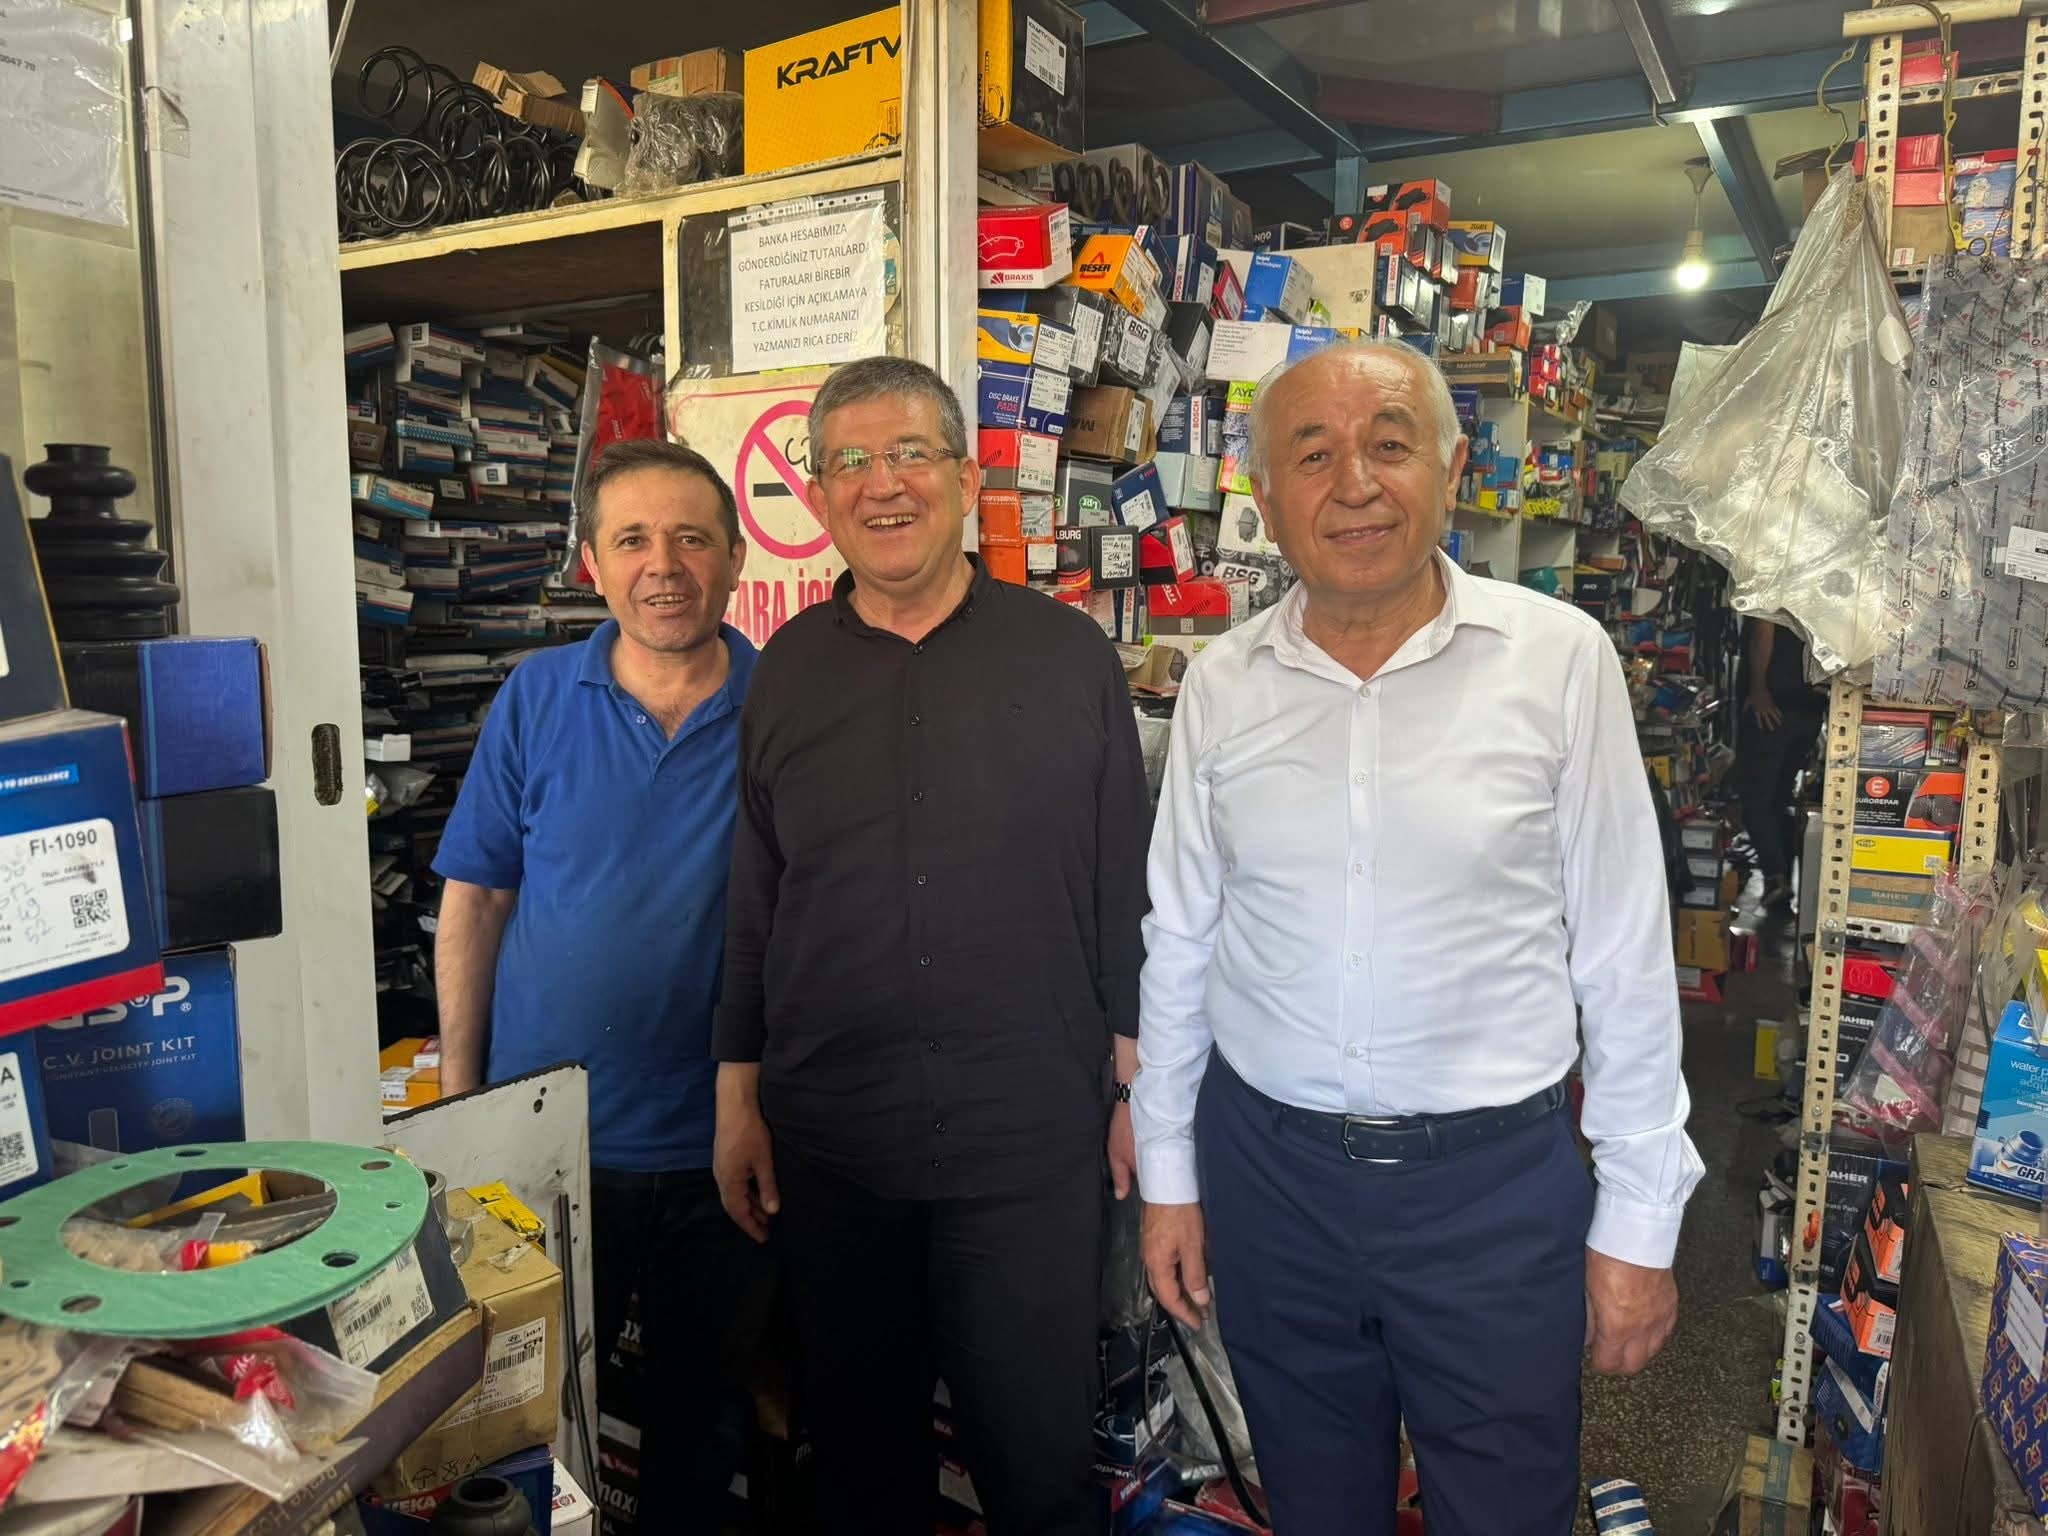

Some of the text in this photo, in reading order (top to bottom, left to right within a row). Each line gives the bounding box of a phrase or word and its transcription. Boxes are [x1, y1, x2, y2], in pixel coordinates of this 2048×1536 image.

[759, 223, 848, 248] BANKA HESABIMIZA
[738, 249, 809, 273] GÖNDERDİĞİNİZ
[760, 266, 851, 290] FATURALARI BİREBİR
[1004, 272, 1034, 281] BRAXIS
[745, 287, 868, 313] KESİLDİĞİ İÇİN AÇIKLAMAYA
[752, 310, 859, 332] T.C.KİMLİK NUMARANIZI
[1129, 319, 1149, 341] BSG
[753, 338, 801, 353] YAZMANIZI
[996, 400, 1018, 412] PADS
[1002, 393, 1020, 403] BRAKE
[1222, 565, 1261, 587] BSG
[29, 828, 98, 857] FI-1090
[92, 1042, 154, 1065] JOINT
[161, 1035, 196, 1052] KIT
[151, 1055, 178, 1067] JOINT
[181, 1052, 198, 1062] KIT
[2010, 1061, 2041, 1074] water
